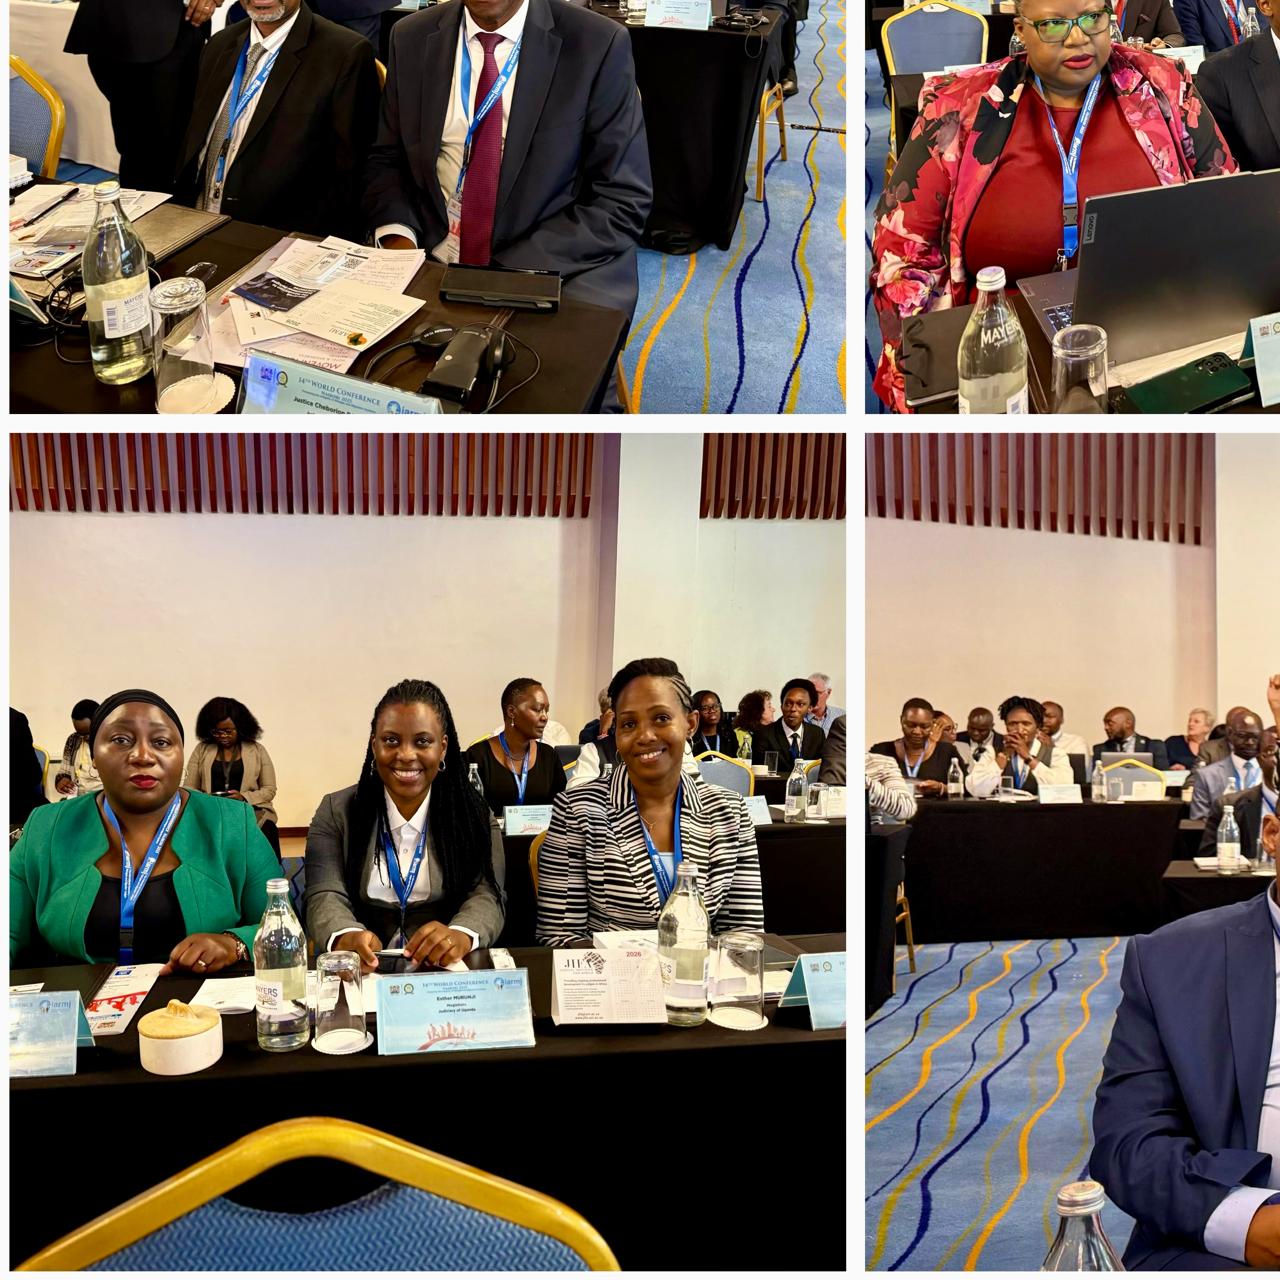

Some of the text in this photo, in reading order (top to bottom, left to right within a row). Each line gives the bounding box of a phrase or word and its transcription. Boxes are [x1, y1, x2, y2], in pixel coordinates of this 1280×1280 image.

[1085, 214, 1096, 242] Lenovo
[311, 380, 336, 393] WORLD
[336, 387, 381, 406] CONFERENCE
[294, 395, 314, 407] Justice
[504, 977, 522, 987] iarmj
[51, 1000, 71, 1009] iarmj
